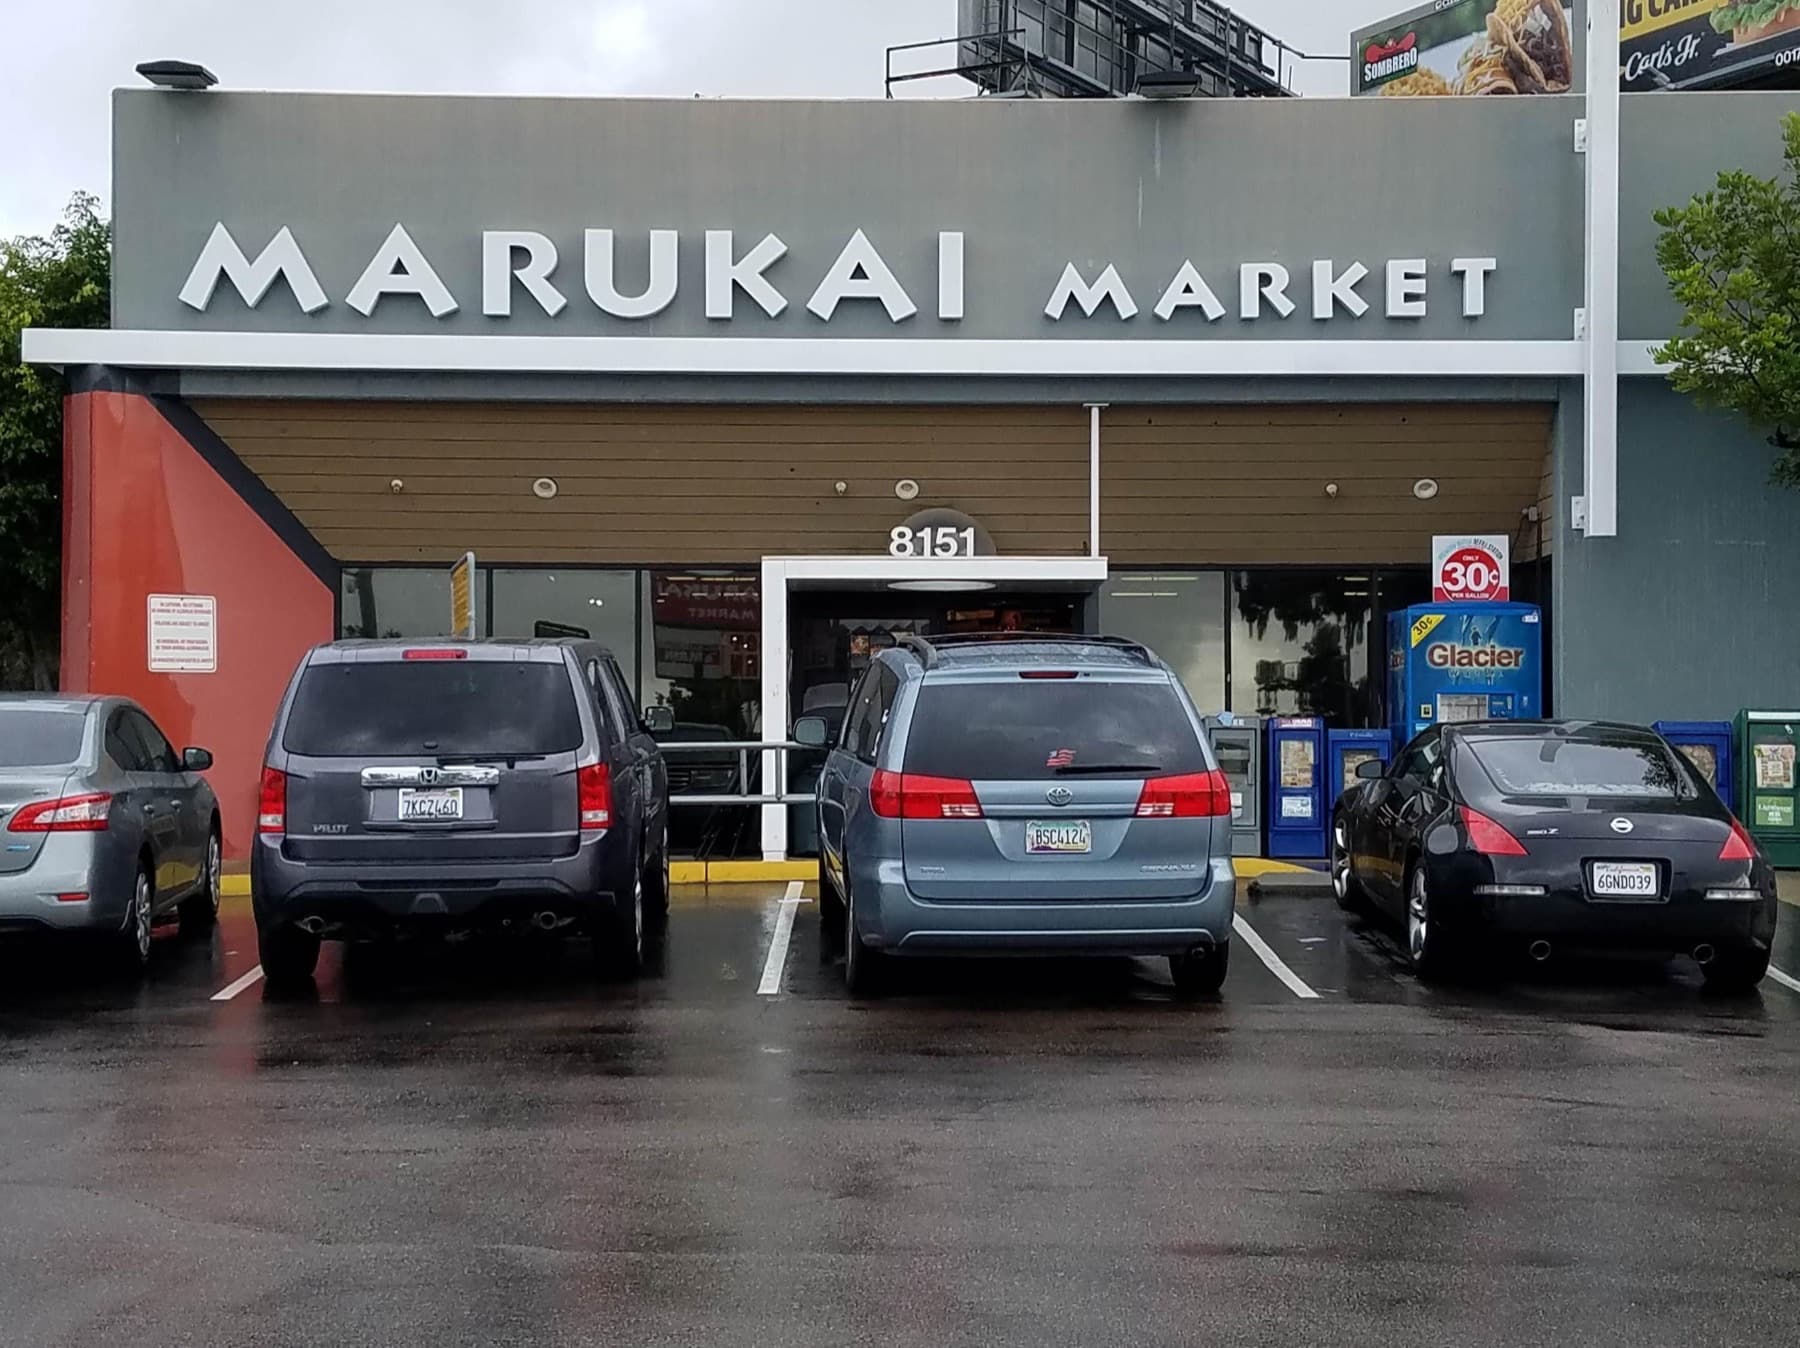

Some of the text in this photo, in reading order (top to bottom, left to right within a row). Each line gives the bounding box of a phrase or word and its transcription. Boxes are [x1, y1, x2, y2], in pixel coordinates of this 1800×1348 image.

[1364, 46, 1418, 82] SOMBRERO
[1625, 32, 1702, 81] Carl's Jr.
[178, 221, 1497, 322] MARUKAI MARKET
[889, 526, 975, 558] 8151
[1443, 562, 1499, 592] 30¢
[1427, 643, 1524, 668] Glacier
[1036, 829, 1086, 845] BSC4124
[1598, 874, 1651, 890] 6GND039
